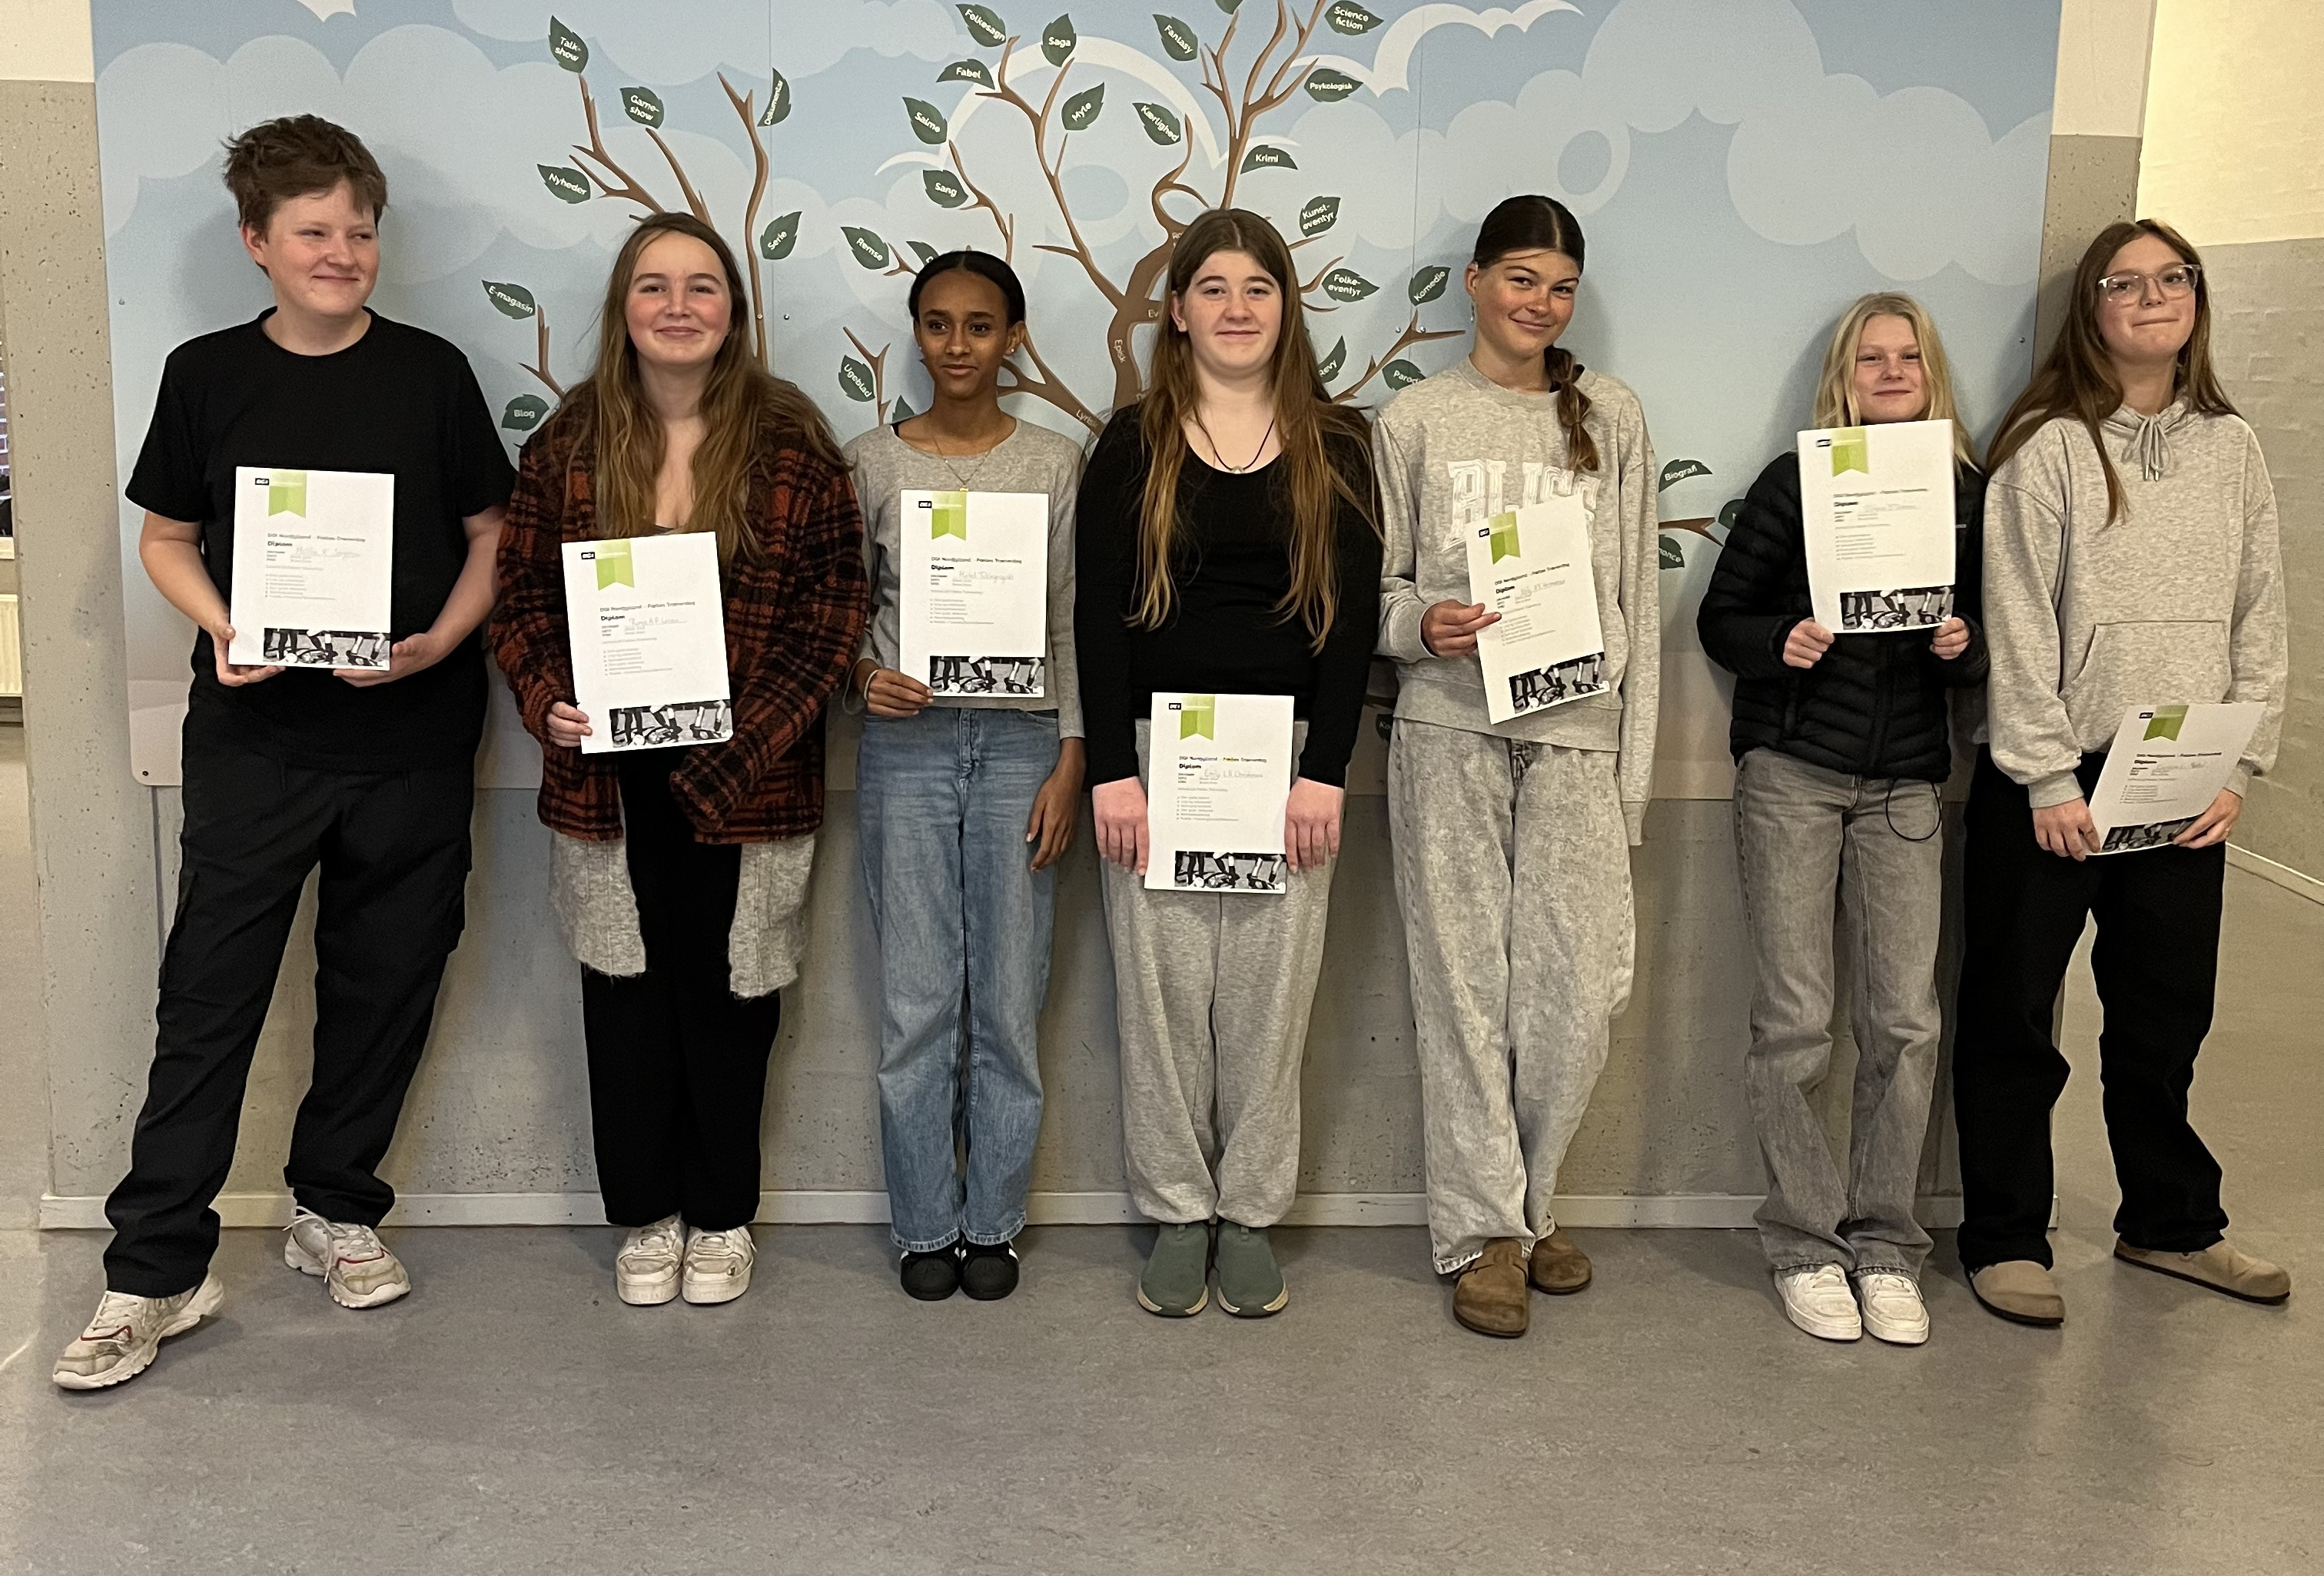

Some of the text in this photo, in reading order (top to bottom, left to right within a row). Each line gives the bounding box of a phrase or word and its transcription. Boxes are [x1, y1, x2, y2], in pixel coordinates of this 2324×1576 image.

[1334, 6, 1370, 22] Science
[964, 8, 1006, 42] Folkesagn
[1336, 16, 1363, 31] fiction
[560, 37, 582, 51] Talk-
[1048, 37, 1071, 48] Saga
[1164, 25, 1194, 54] Fantasy
[555, 47, 579, 61] show
[956, 67, 981, 78] Fabel
[1310, 82, 1353, 91] Psykologisk
[630, 95, 659, 112] Game-
[629, 106, 653, 121] show
[1071, 102, 1092, 122] Myte
[915, 111, 941, 133] Salme
[1140, 105, 1180, 141] Kærlighed
[1255, 154, 1279, 163] Krimi
[549, 173, 587, 195] Nyheder
[935, 182, 958, 197] Sang
[1303, 204, 1330, 220] Kunst-
[1303, 212, 1335, 231] eventyr
[768, 231, 788, 251] Serie
[856, 237, 883, 261] Remse
[1333, 274, 1361, 286] Folke-
[1414, 271, 1445, 301] Komedie
[1328, 284, 1362, 297] eventyr
[488, 285, 533, 314] E-magasin
[844, 363, 872, 397] Ugeblad
[513, 410, 535, 419] Blog
[1665, 464, 1698, 481] Biografi
